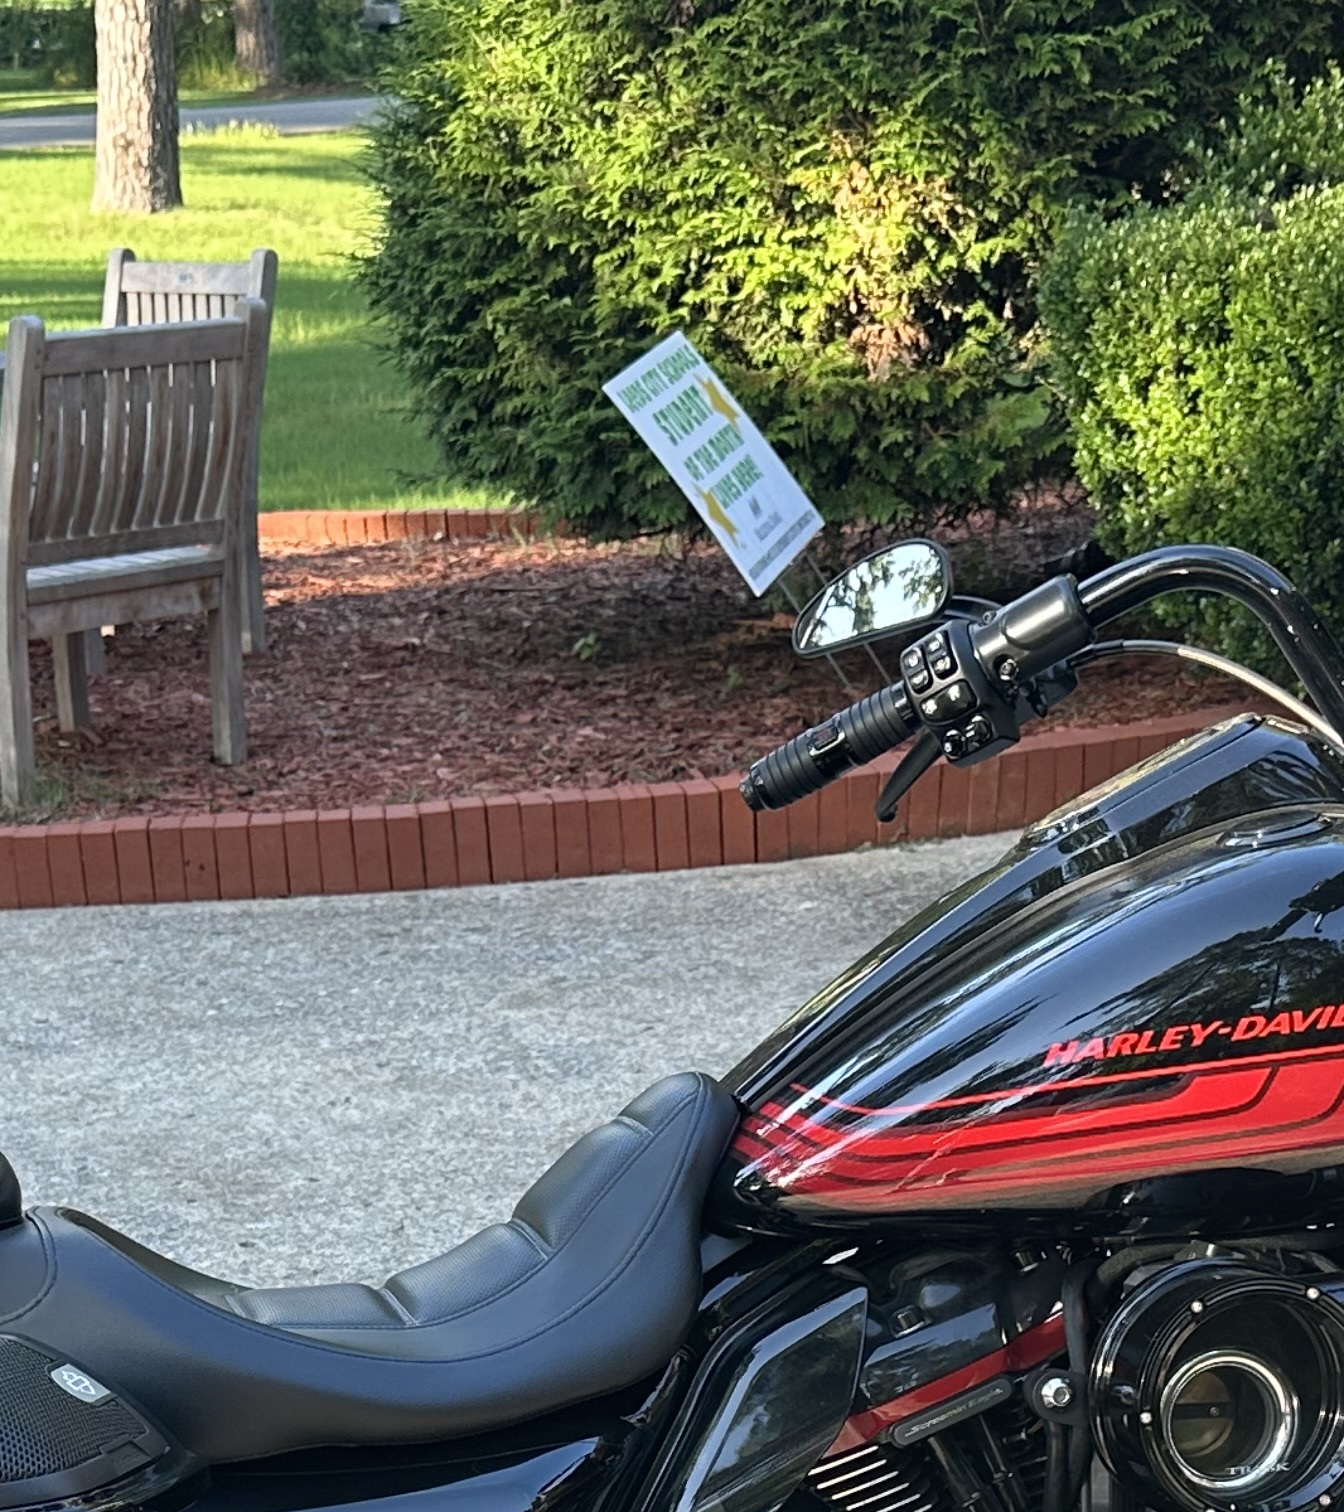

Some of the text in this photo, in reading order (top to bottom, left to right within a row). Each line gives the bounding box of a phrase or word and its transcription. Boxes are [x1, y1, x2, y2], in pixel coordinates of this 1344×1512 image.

[641, 368, 668, 397] CITY
[657, 344, 699, 384] SCHOOLS
[652, 384, 713, 446] STUDENT
[694, 445, 718, 473] THE
[708, 423, 743, 461] MONTH
